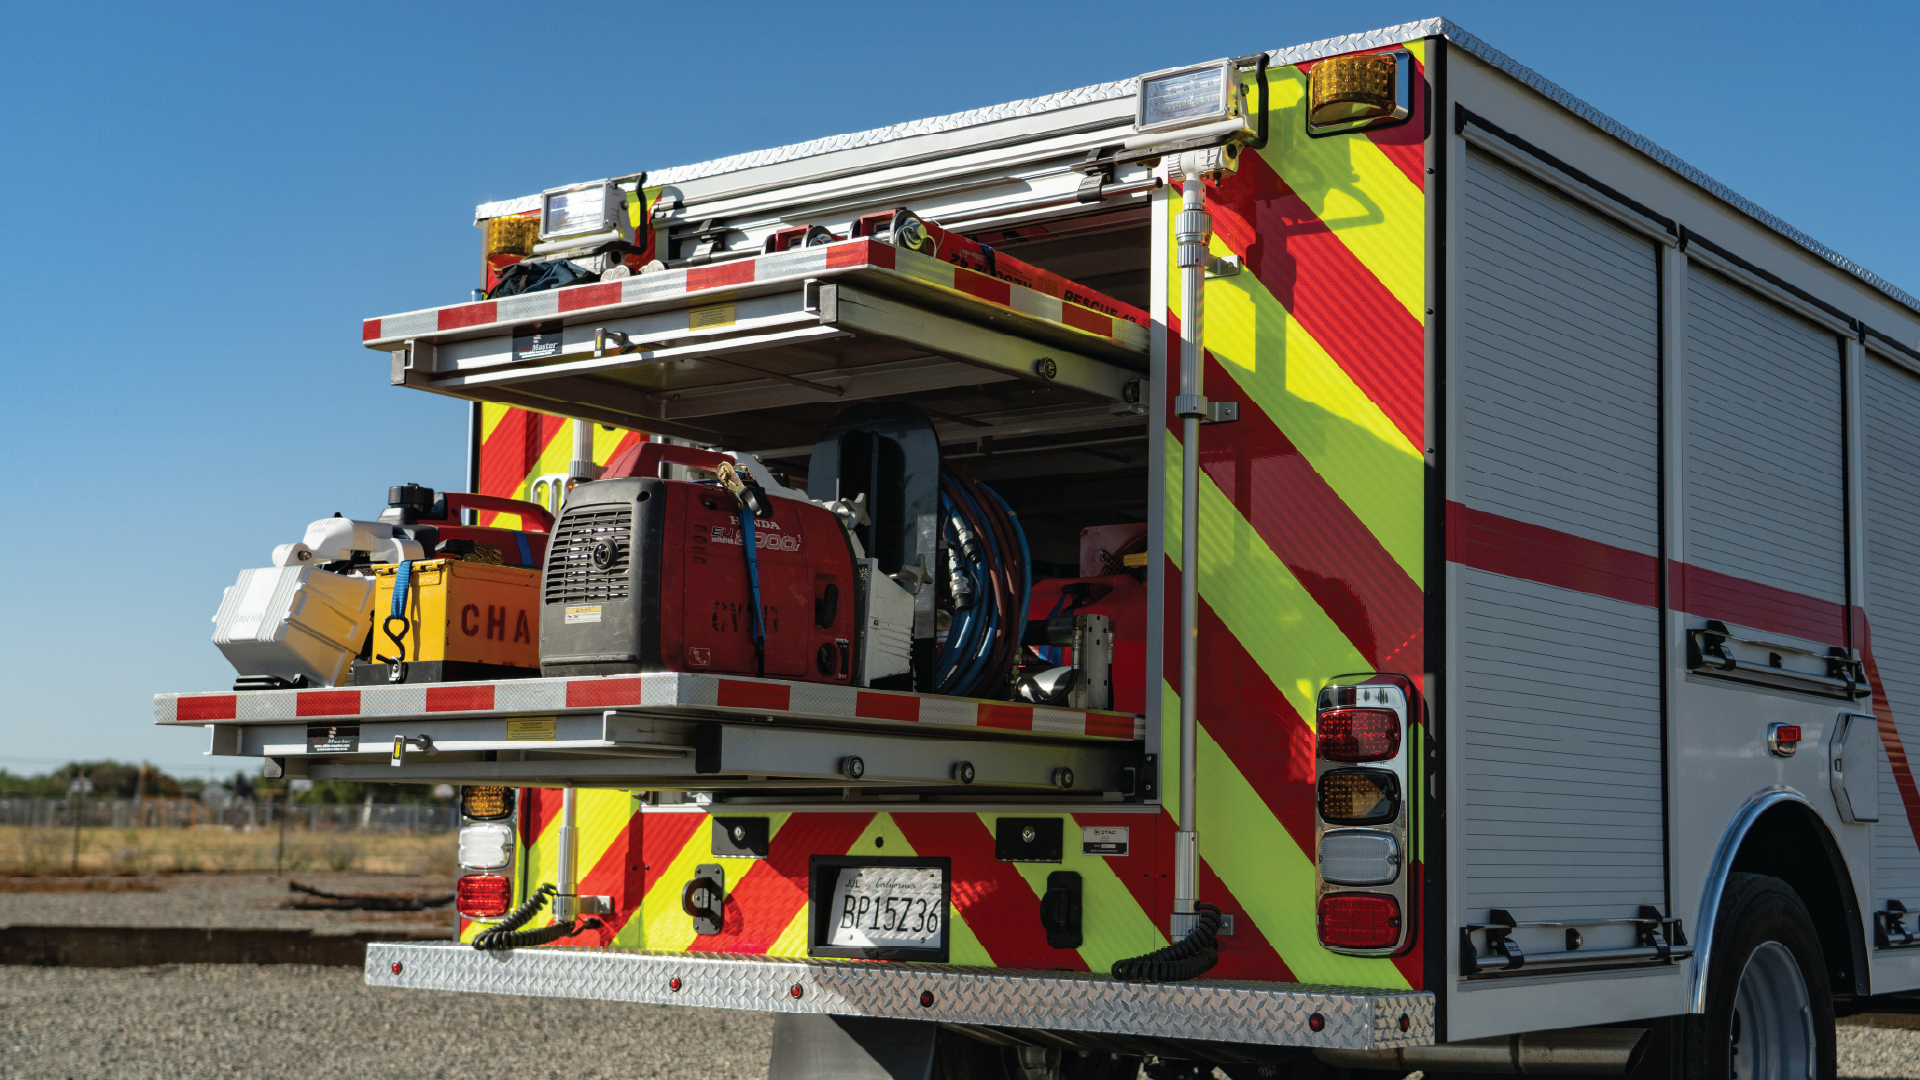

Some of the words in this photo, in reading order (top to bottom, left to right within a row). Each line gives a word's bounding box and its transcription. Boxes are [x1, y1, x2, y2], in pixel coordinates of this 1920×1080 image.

[729, 515, 782, 530] HNDA
[710, 526, 735, 538] EU
[460, 603, 531, 644] CHA
[845, 878, 861, 889] JUL
[875, 876, 917, 894] California
[840, 894, 942, 934] BP15Z36
